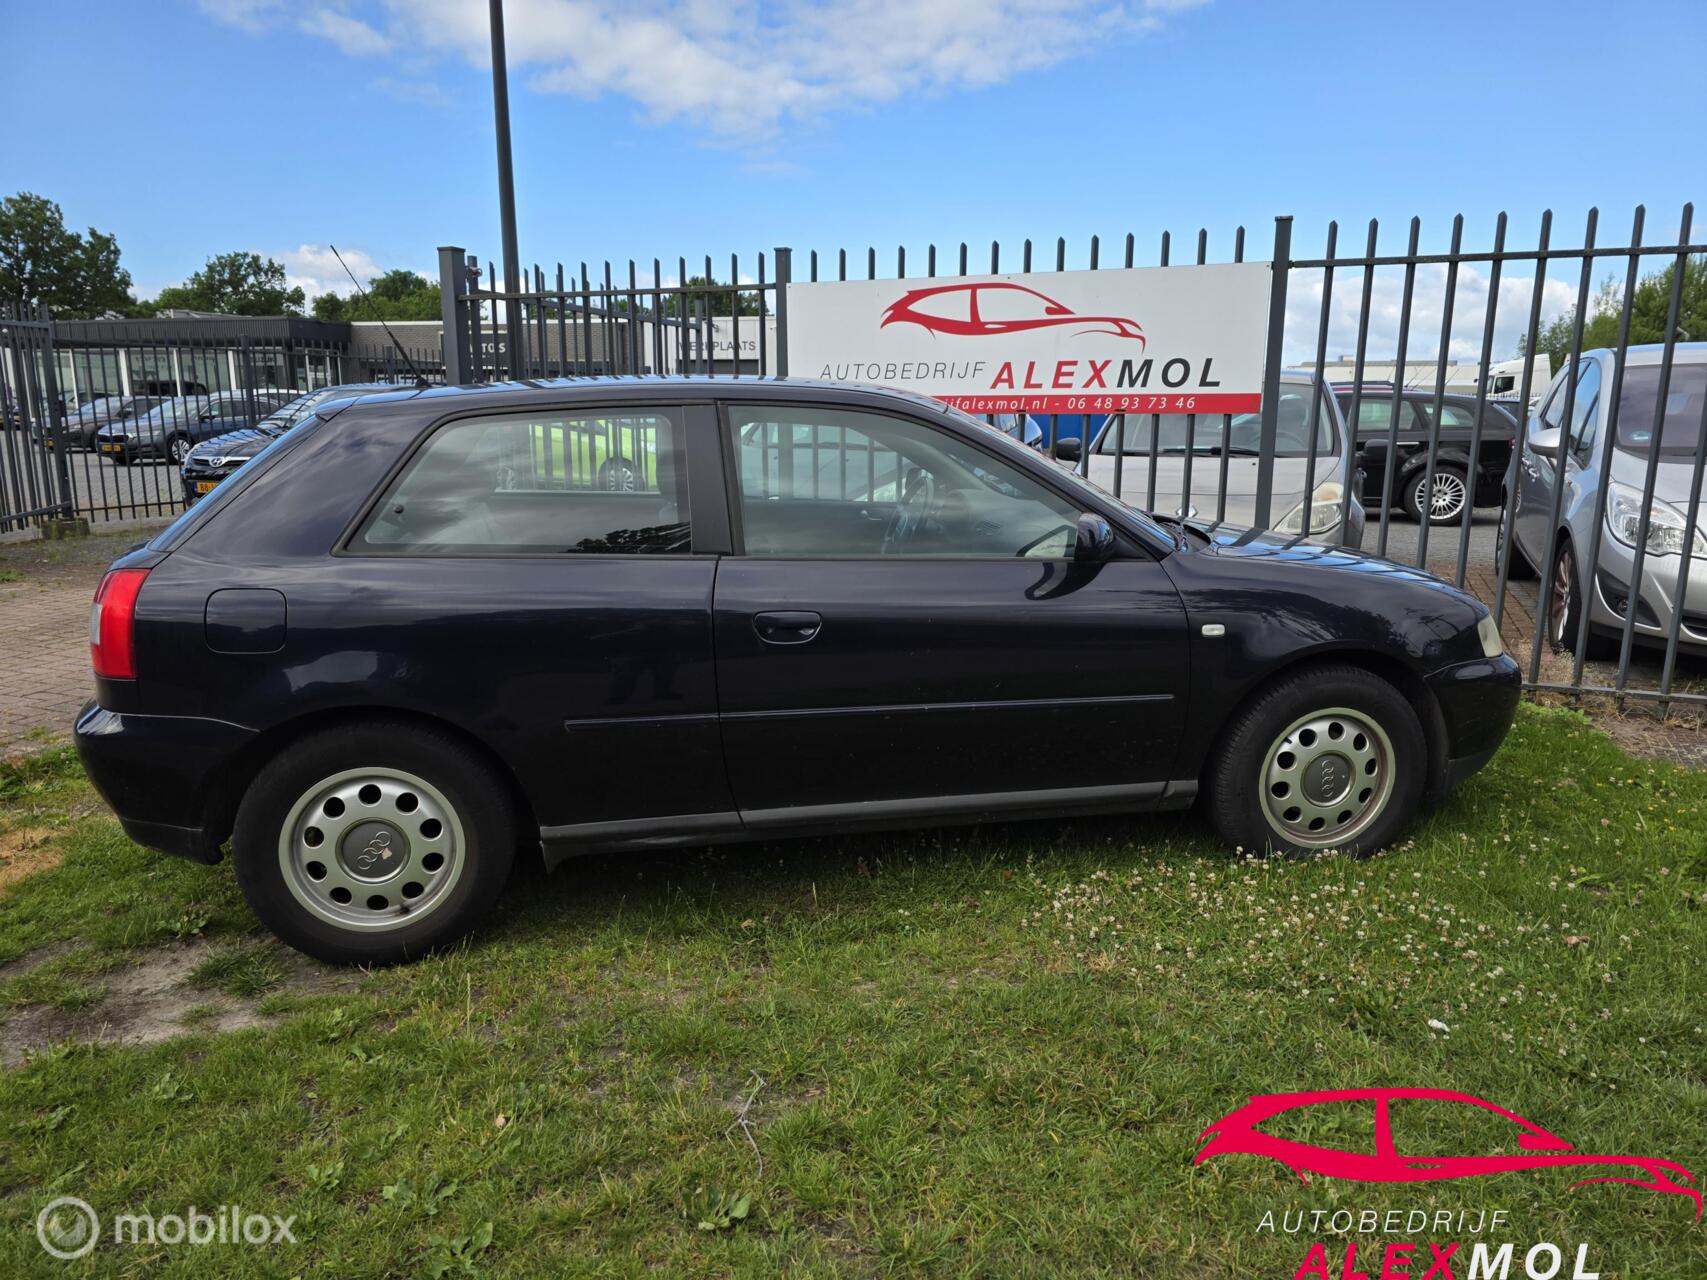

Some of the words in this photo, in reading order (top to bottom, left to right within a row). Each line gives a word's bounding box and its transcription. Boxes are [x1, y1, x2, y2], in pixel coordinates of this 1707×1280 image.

[820, 361, 986, 380] AUTOBEDRIJF
[989, 357, 1222, 390] ALEXMOL
[1067, 397, 1086, 409] 06
[1094, 397, 1113, 409] 48
[1120, 396, 1140, 409] 93
[1148, 396, 1167, 409] 73
[1175, 396, 1197, 409] 46
